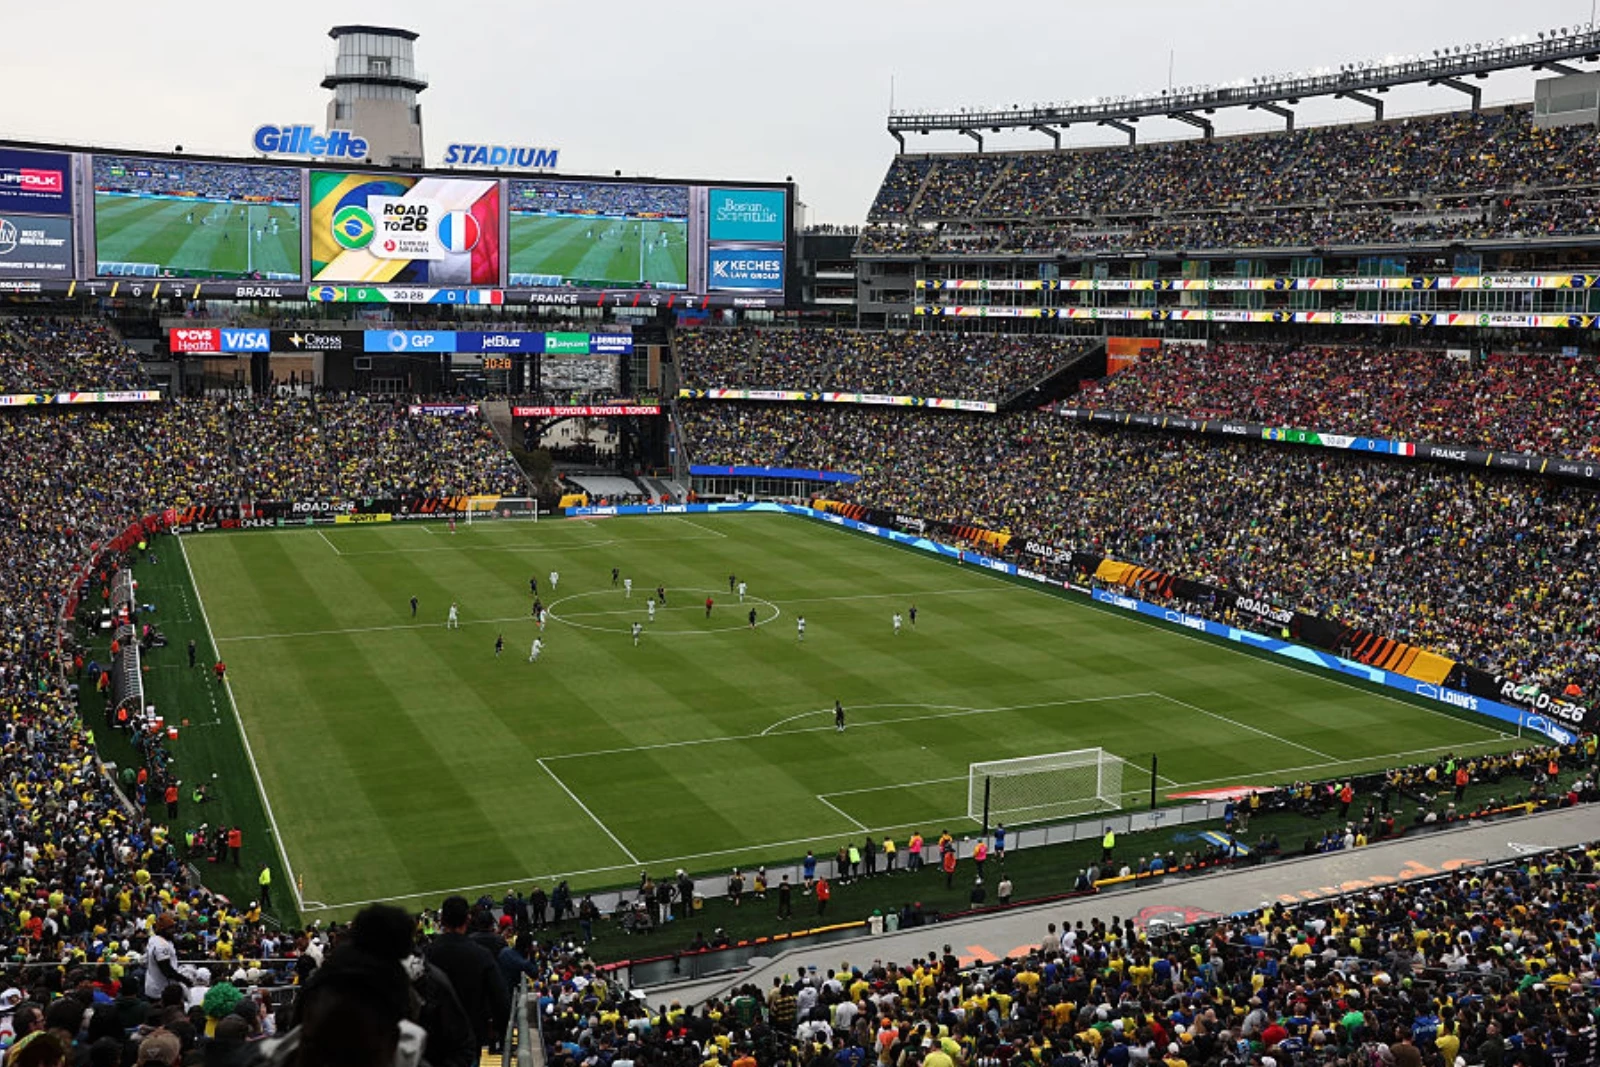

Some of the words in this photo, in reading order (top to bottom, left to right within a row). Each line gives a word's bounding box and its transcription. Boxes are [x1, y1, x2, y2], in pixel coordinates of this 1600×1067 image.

[255, 126, 367, 158] Gillette
[445, 144, 558, 168] STADIUM
[383, 204, 429, 216] ROAD
[725, 198, 762, 212] Boston
[716, 207, 777, 223] Scientific
[384, 221, 400, 231] TO
[400, 216, 428, 231] 26
[730, 260, 780, 271] KECHES
[750, 272, 780, 280] GROUP
[90, 287, 96, 296] 1
[133, 287, 141, 297] 0
[236, 287, 282, 298] BRAZIL
[357, 289, 366, 299] 0
[447, 291, 456, 300] 0
[530, 294, 578, 304] FRANCE
[188, 330, 212, 340] CVS
[222, 332, 269, 348] VISA
[412, 335, 434, 347] GP
[482, 335, 521, 349] jetBlue
[483, 358, 512, 369] 30:28
[517, 407, 552, 415] TOYOTA
[554, 407, 587, 415] TOYOTA
[590, 406, 623, 415] TOYOTA
[625, 406, 657, 414] TOYOTA
[1222, 424, 1247, 435] BRAZIL
[1368, 439, 1375, 450] 0
[1430, 447, 1467, 460] FRANCE
[1525, 458, 1530, 470] 1
[1585, 466, 1593, 478] 0
[293, 502, 330, 513] ROAD
[1025, 541, 1052, 557] ROAD
[1236, 596, 1269, 615] ROAD
[1548, 702, 1560, 714] TO
[1560, 702, 1586, 722] 26
